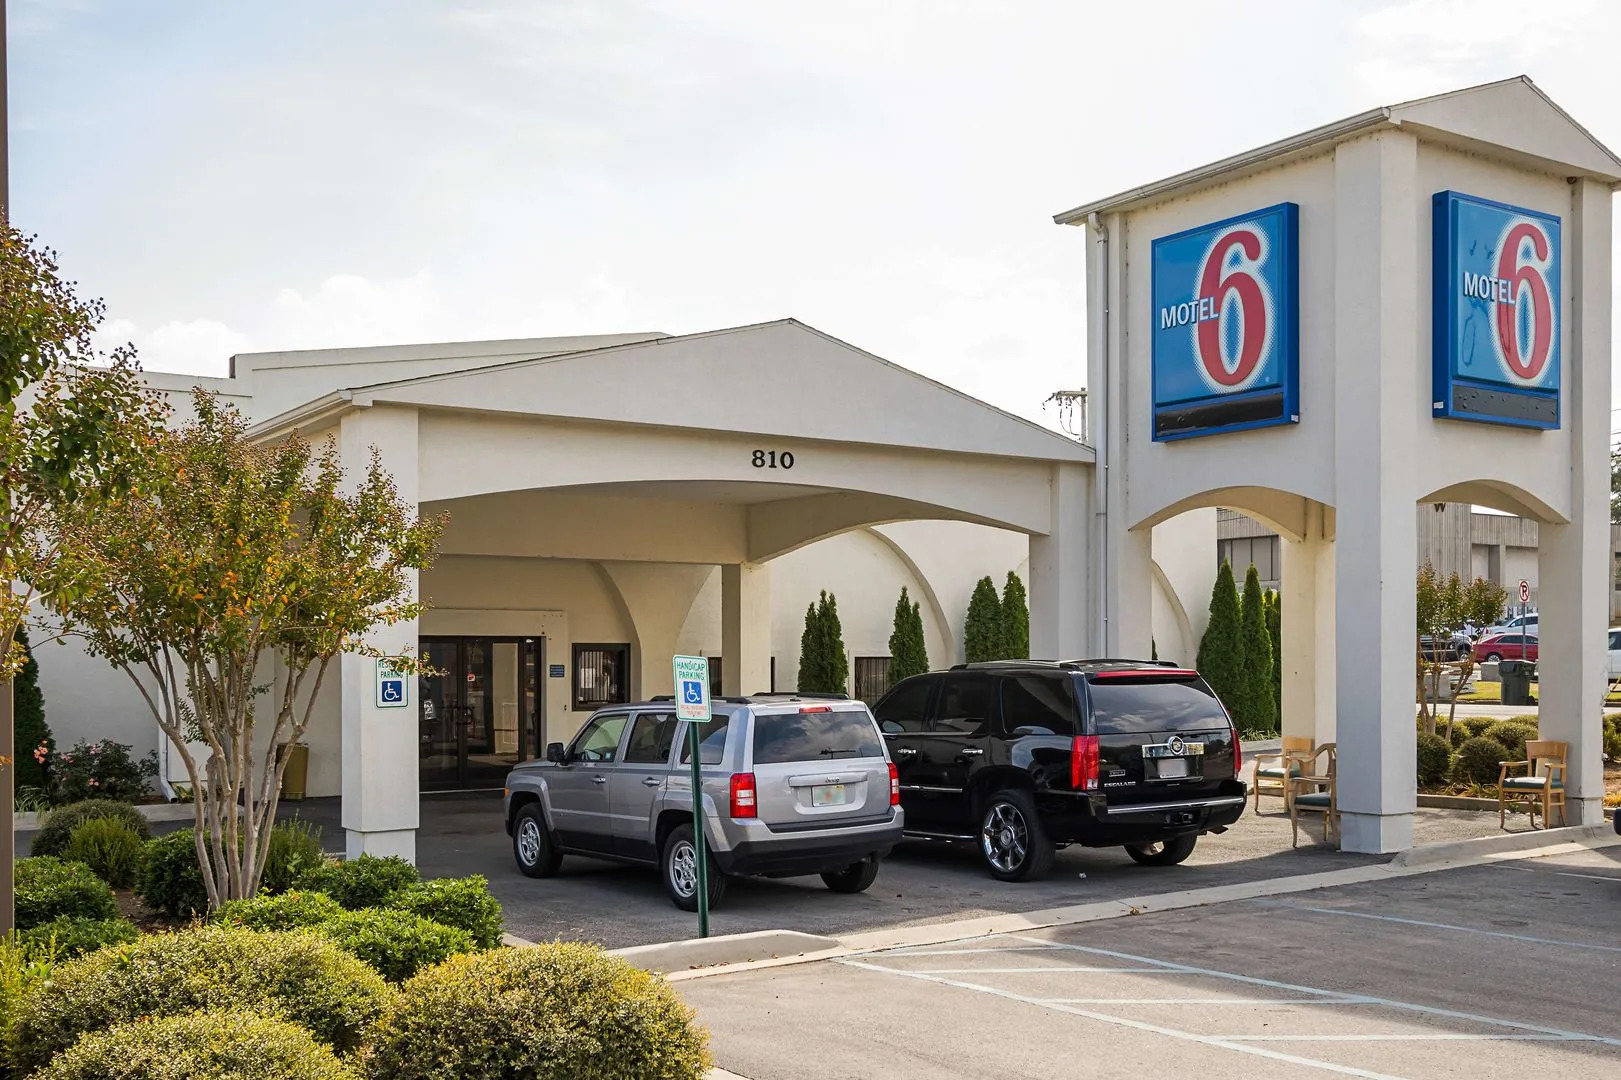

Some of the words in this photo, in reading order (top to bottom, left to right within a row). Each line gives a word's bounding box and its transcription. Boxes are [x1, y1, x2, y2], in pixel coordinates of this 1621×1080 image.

[1161, 297, 1220, 330] MOTEL
[1197, 230, 1267, 386] 6
[1463, 271, 1516, 305] MOTEL
[1496, 222, 1552, 380] 6
[751, 449, 795, 470] 810
[676, 661, 706, 671] HANDICAP
[678, 670, 705, 681] PARKING
